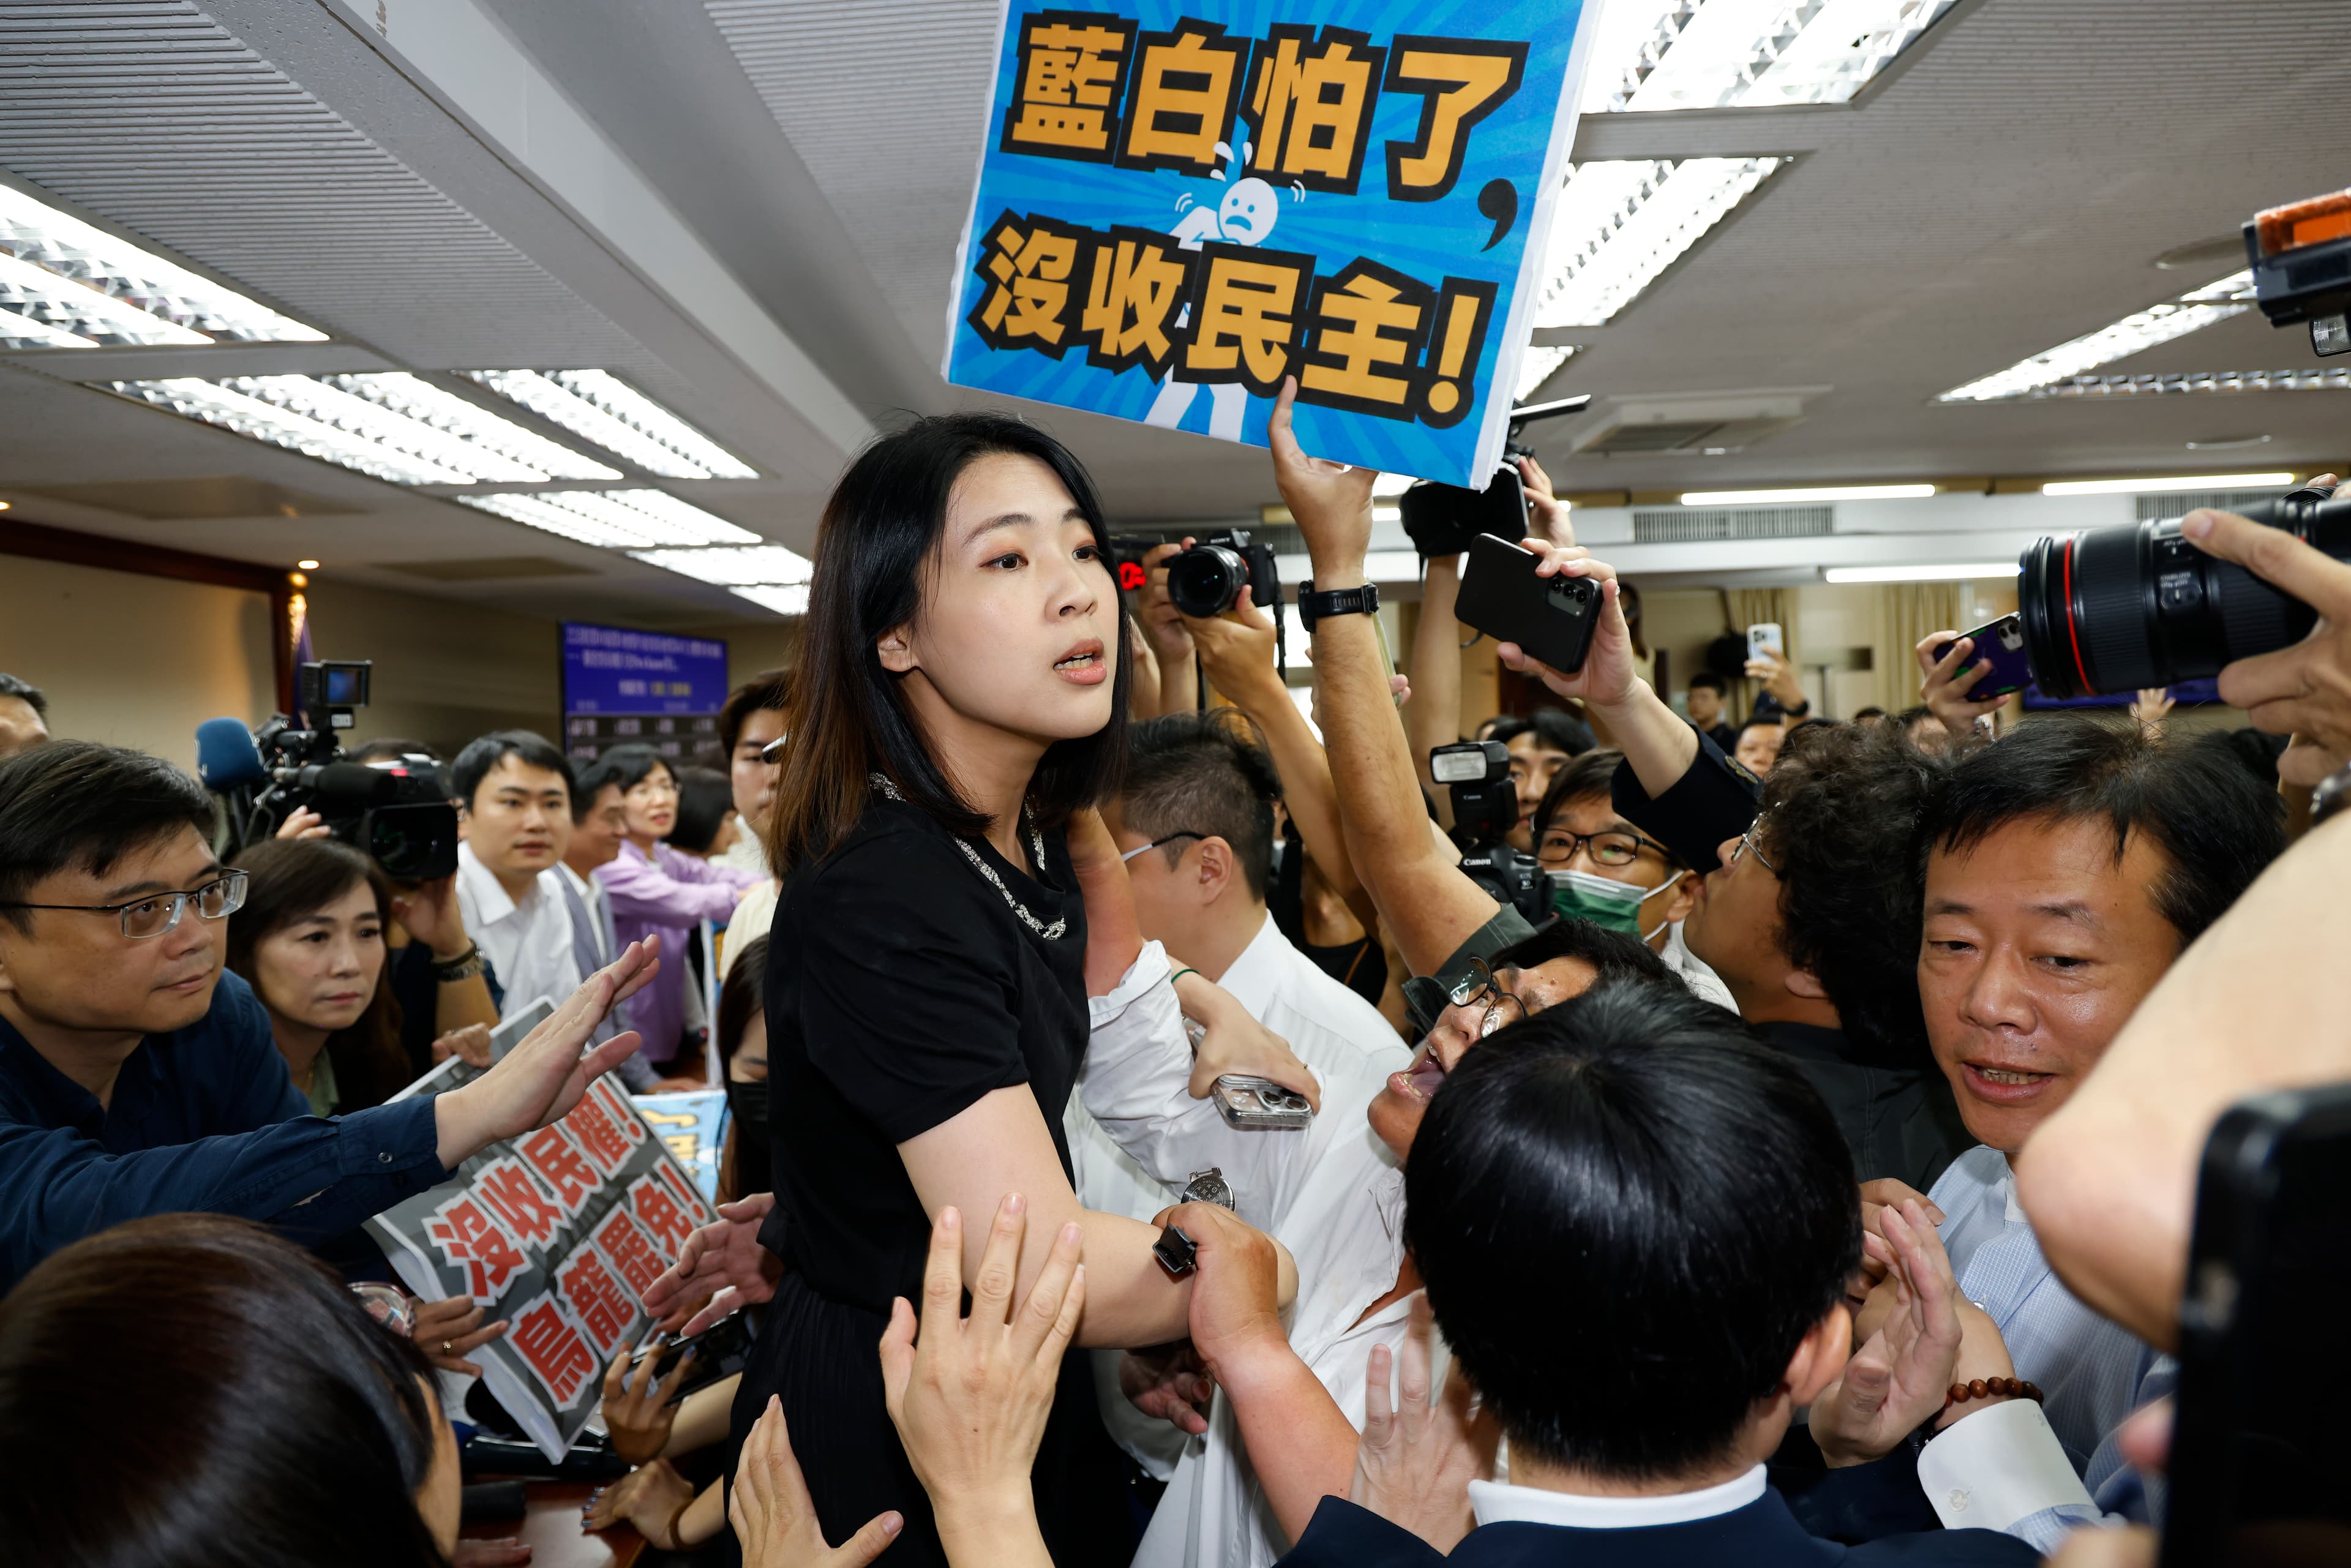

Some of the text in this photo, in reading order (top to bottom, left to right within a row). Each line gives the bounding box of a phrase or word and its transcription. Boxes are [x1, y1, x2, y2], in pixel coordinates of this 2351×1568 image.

[1000, 10, 1529, 252] 藍白怕了，
[967, 208, 1499, 429] 沒收民主！
[422, 1076, 648, 1305] 沒收民權！
